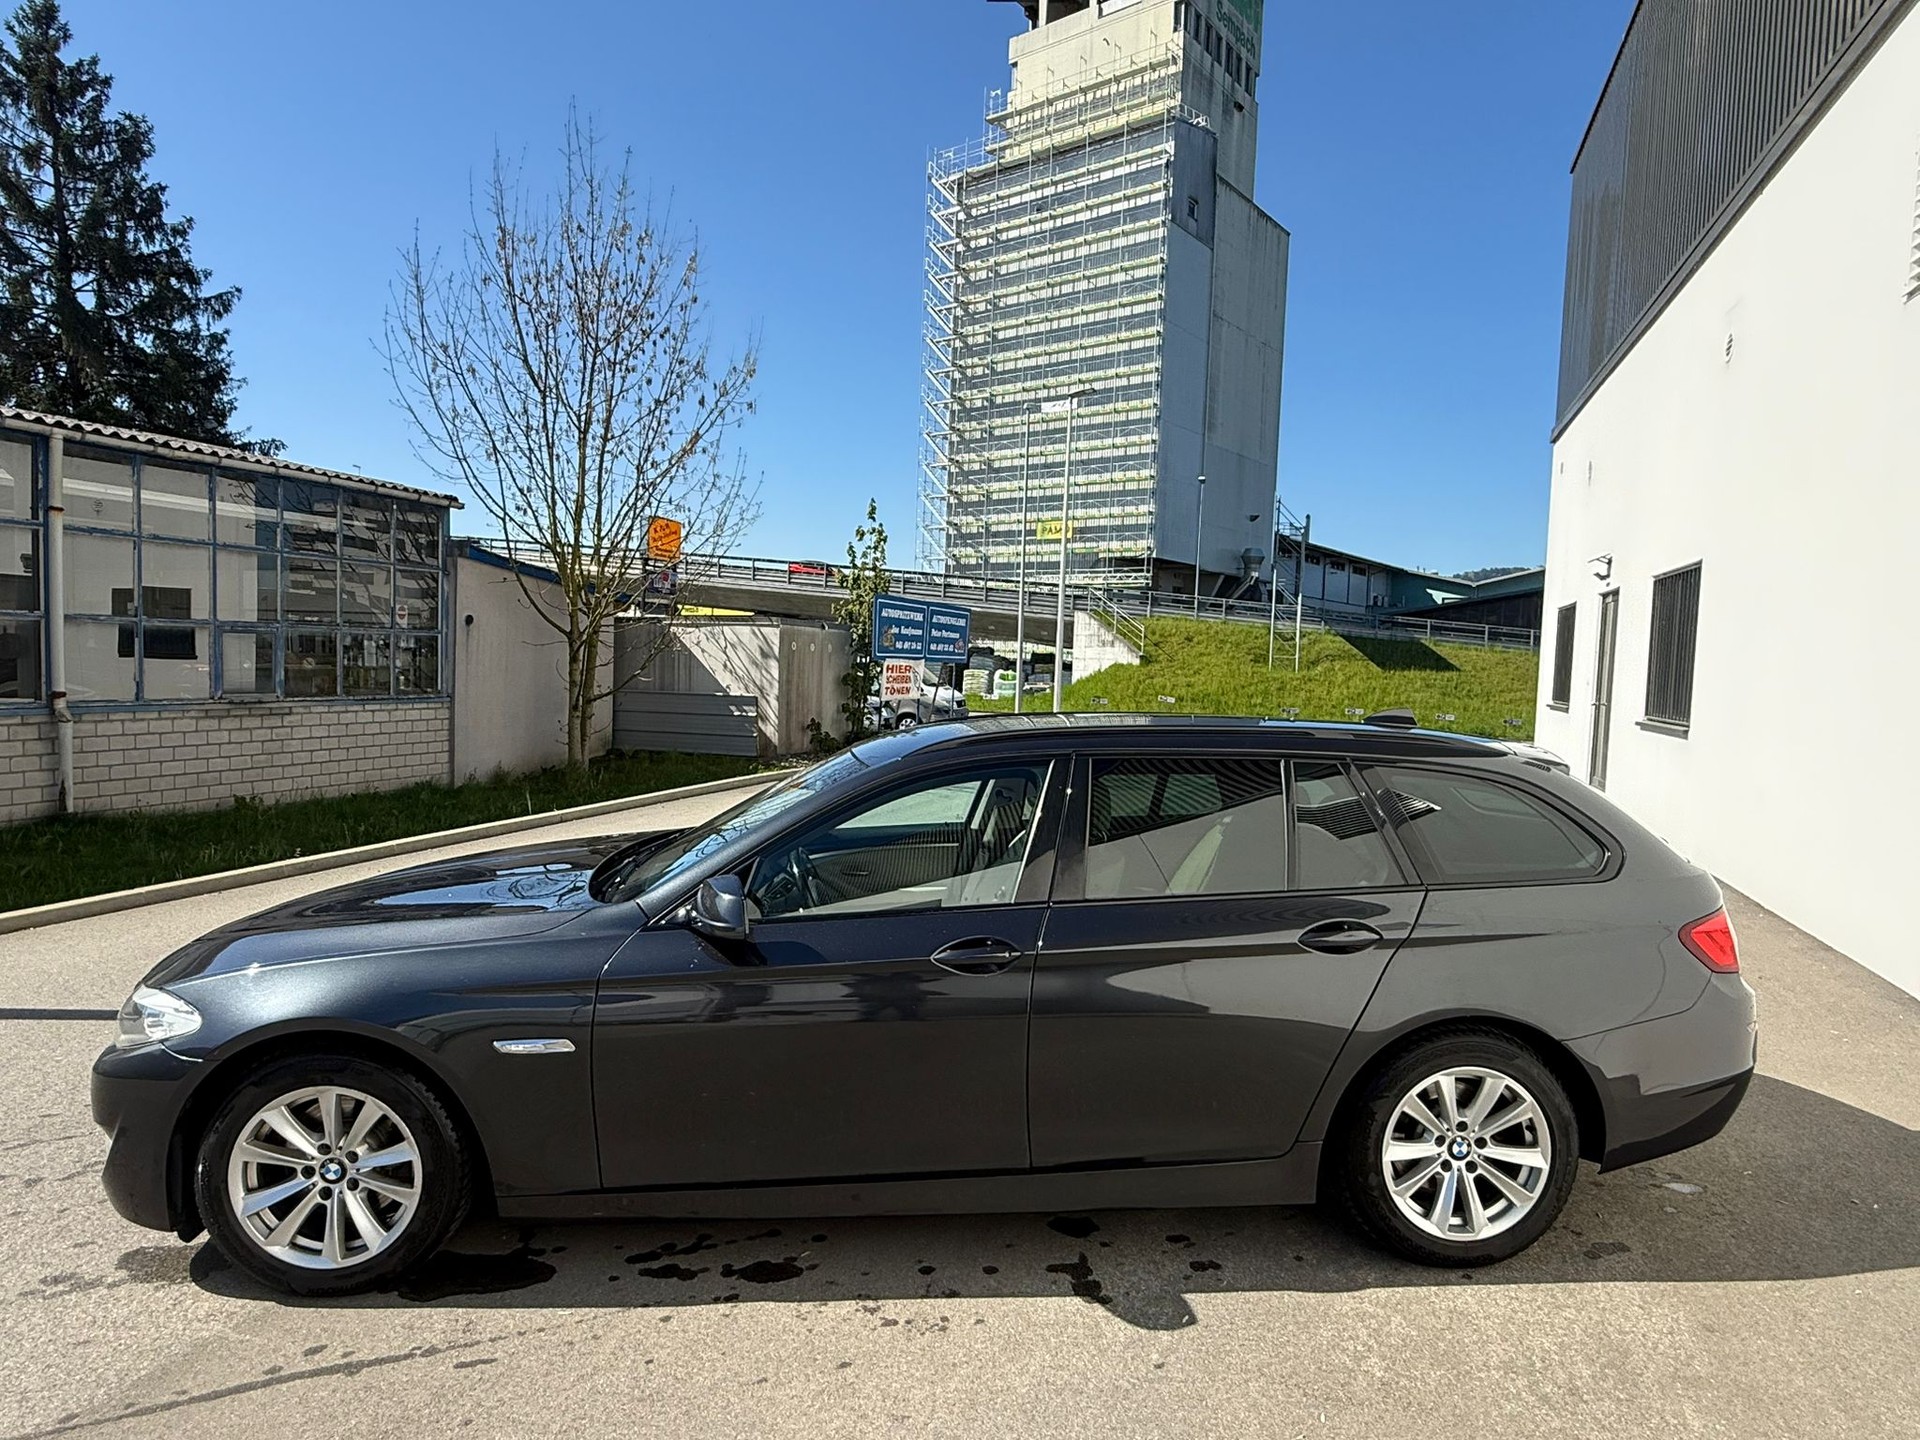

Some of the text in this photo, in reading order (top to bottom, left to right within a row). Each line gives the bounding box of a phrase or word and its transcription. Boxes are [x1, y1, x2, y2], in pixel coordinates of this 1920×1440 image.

[1216, 0, 1256, 59] Sempach
[886, 664, 912, 674] HIER
[885, 685, 911, 695] TÖNEN
